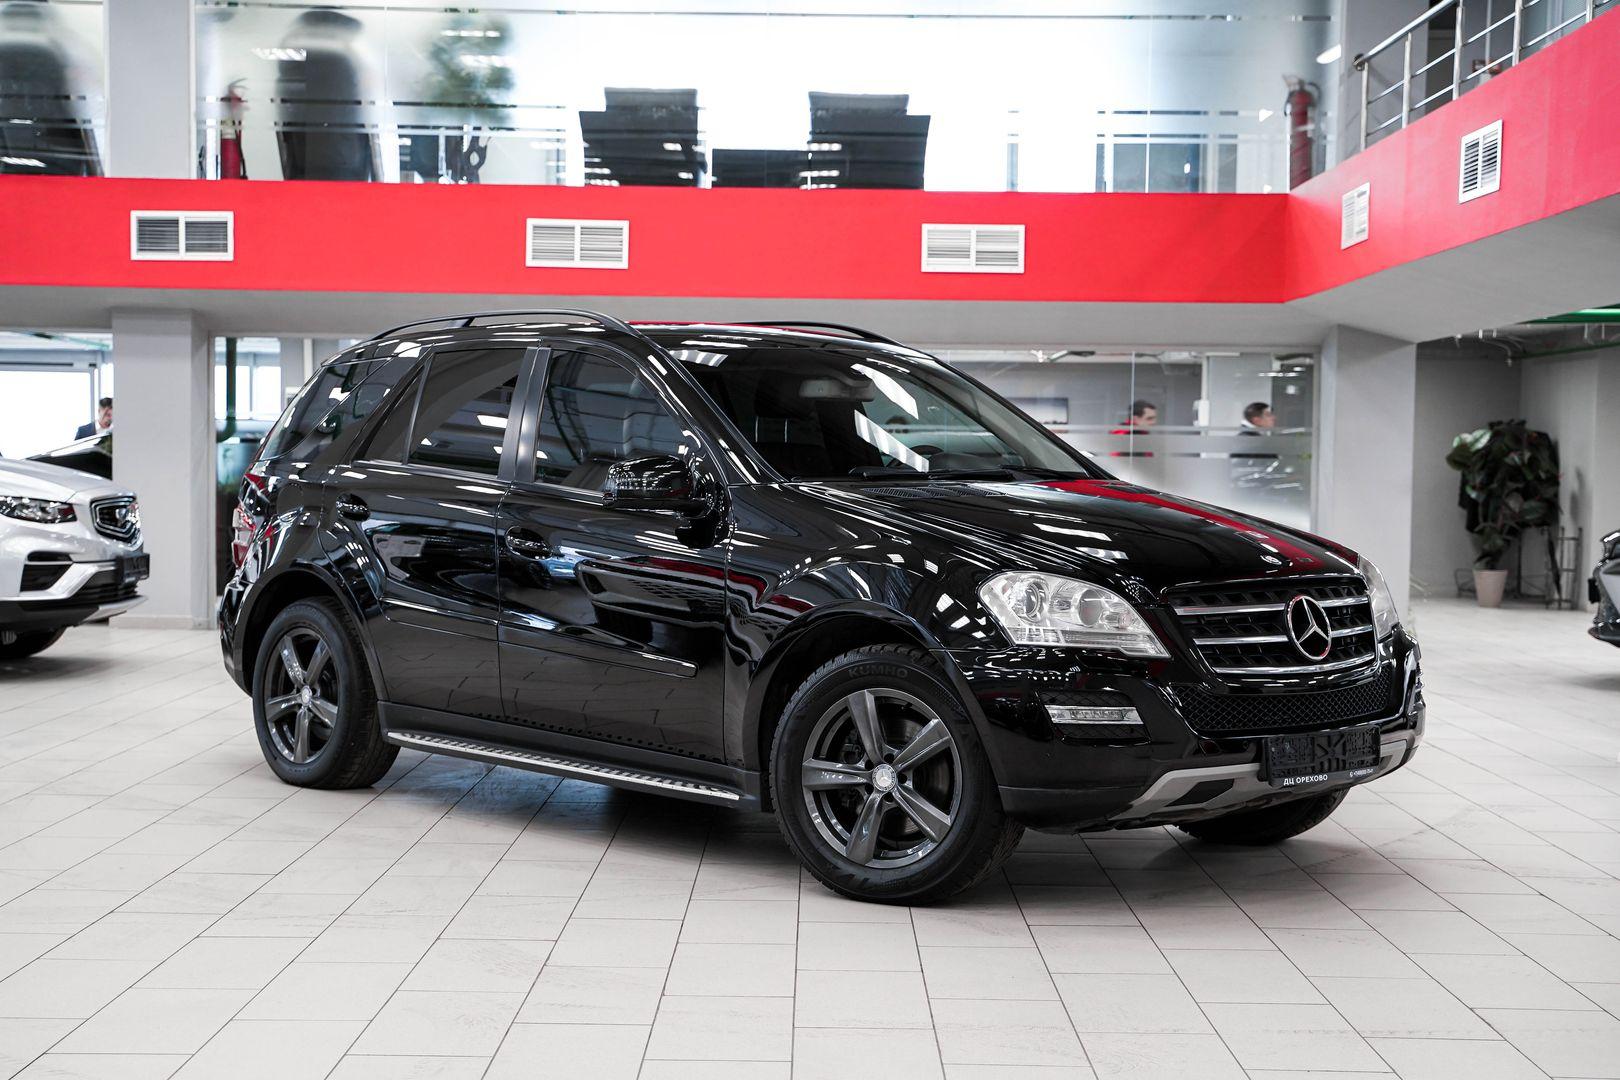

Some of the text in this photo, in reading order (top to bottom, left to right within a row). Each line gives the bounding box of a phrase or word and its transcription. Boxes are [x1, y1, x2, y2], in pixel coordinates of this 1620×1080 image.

[848, 664, 908, 678] KUMHO
[1283, 774, 1328, 786] ДЦ ОРЕХОВО
